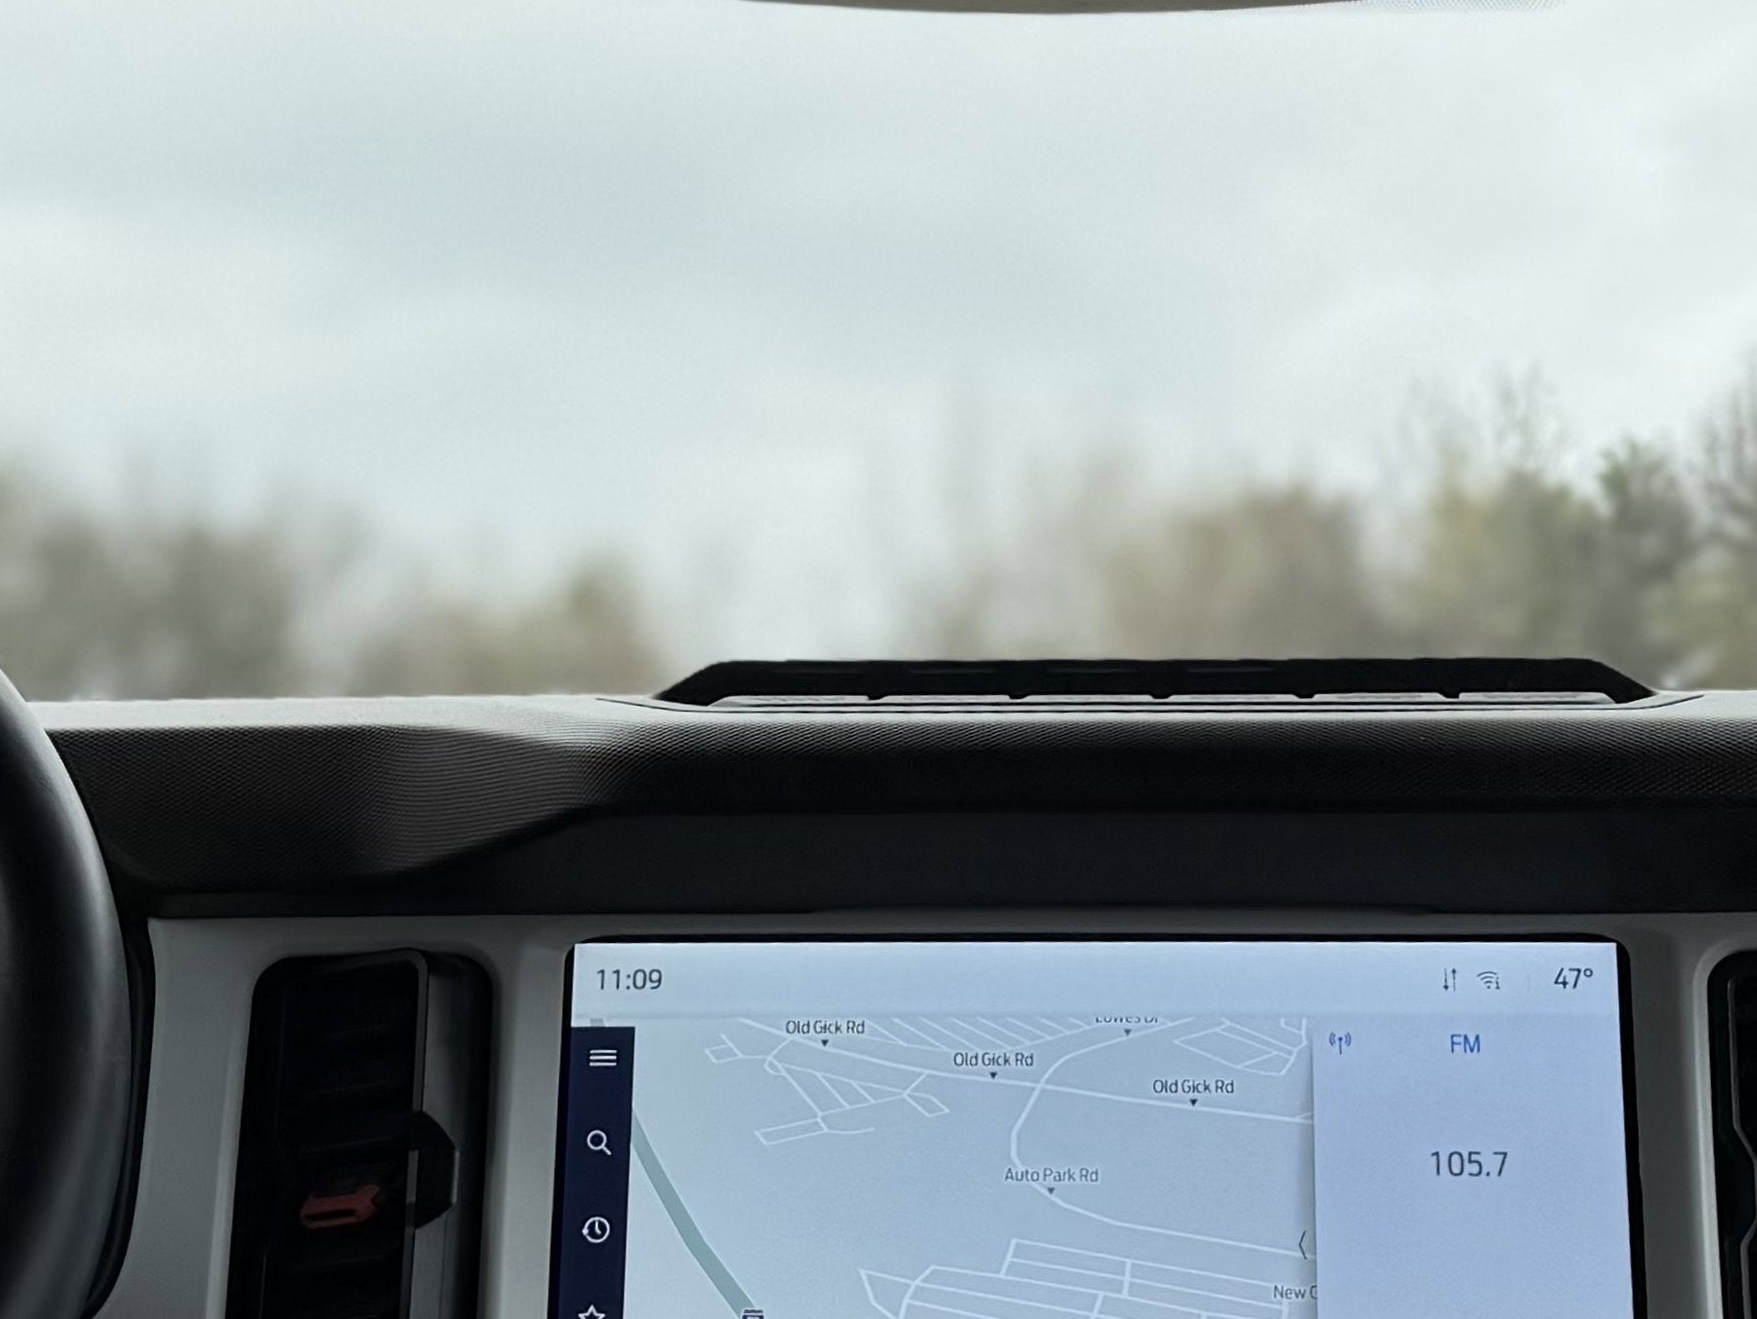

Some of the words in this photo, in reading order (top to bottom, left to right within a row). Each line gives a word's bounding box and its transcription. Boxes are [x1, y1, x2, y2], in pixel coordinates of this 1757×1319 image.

[596, 968, 663, 991] 11:09
[1553, 967, 1595, 991] 47°
[785, 1019, 811, 1035] Old
[814, 1019, 840, 1035] Gick
[843, 1019, 866, 1035] Rd
[1450, 1034, 1481, 1054] FM
[953, 1051, 979, 1067] Old
[982, 1051, 1008, 1067] Gick
[1011, 1051, 1034, 1067] Rd
[1152, 1079, 1179, 1095] Old
[1181, 1079, 1209, 1095] Gick
[1214, 1079, 1235, 1095] Rd
[1429, 1150, 1509, 1178] 105.7
[1004, 1167, 1040, 1183] Auto
[1043, 1167, 1075, 1183] Park
[1078, 1167, 1099, 1183] Rd
[1273, 1285, 1306, 1299] New
